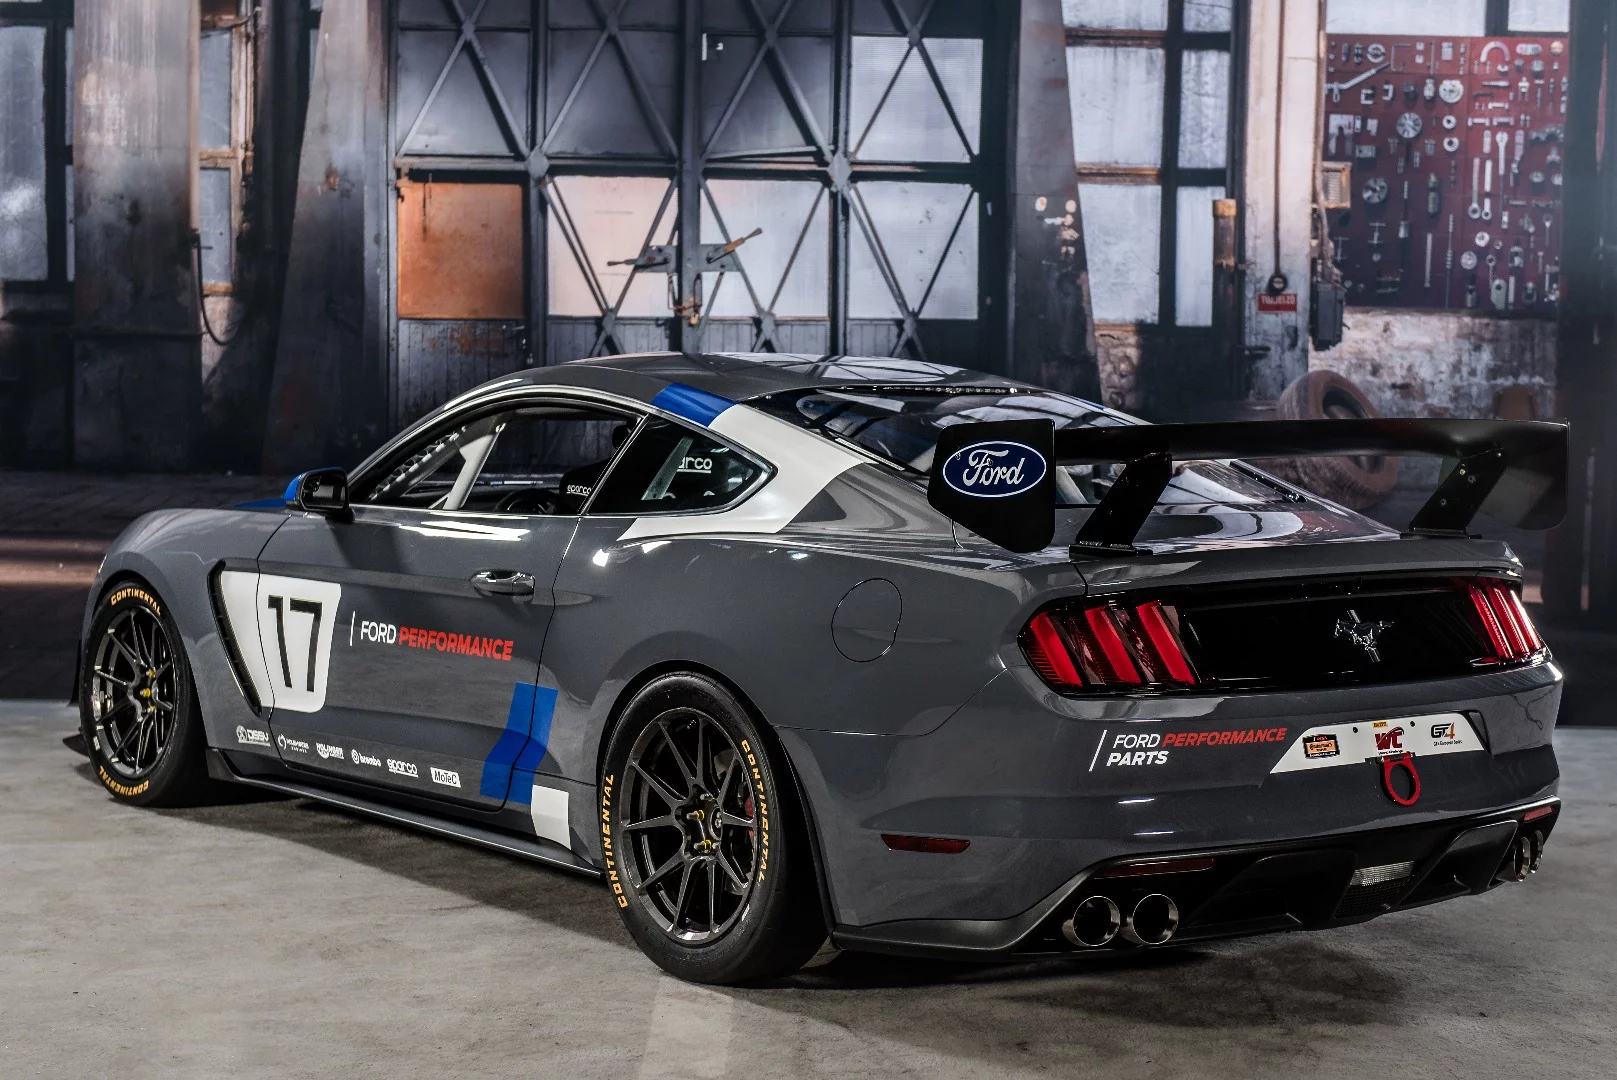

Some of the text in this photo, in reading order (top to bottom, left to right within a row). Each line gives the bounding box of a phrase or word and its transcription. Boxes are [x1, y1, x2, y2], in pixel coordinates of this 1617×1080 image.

[678, 456, 713, 470] arco
[963, 449, 1026, 486] Ford
[110, 587, 161, 616] CONTINENTAL
[267, 594, 323, 692] 17
[360, 620, 514, 661] FORD PERFORMANCE
[1113, 733, 1161, 749] FORD
[1162, 727, 1288, 748] PERFORMANCE
[1374, 730, 1403, 750] WC
[1430, 722, 1456, 740] GT4
[386, 758, 418, 775] sparco
[1106, 750, 1170, 767] PARTS
[100, 765, 150, 796] CONTINENTAL
[434, 770, 457, 785] MoTeC
[741, 739, 769, 882] CONTINENTAL
[602, 774, 628, 908] CONTINENTAL
